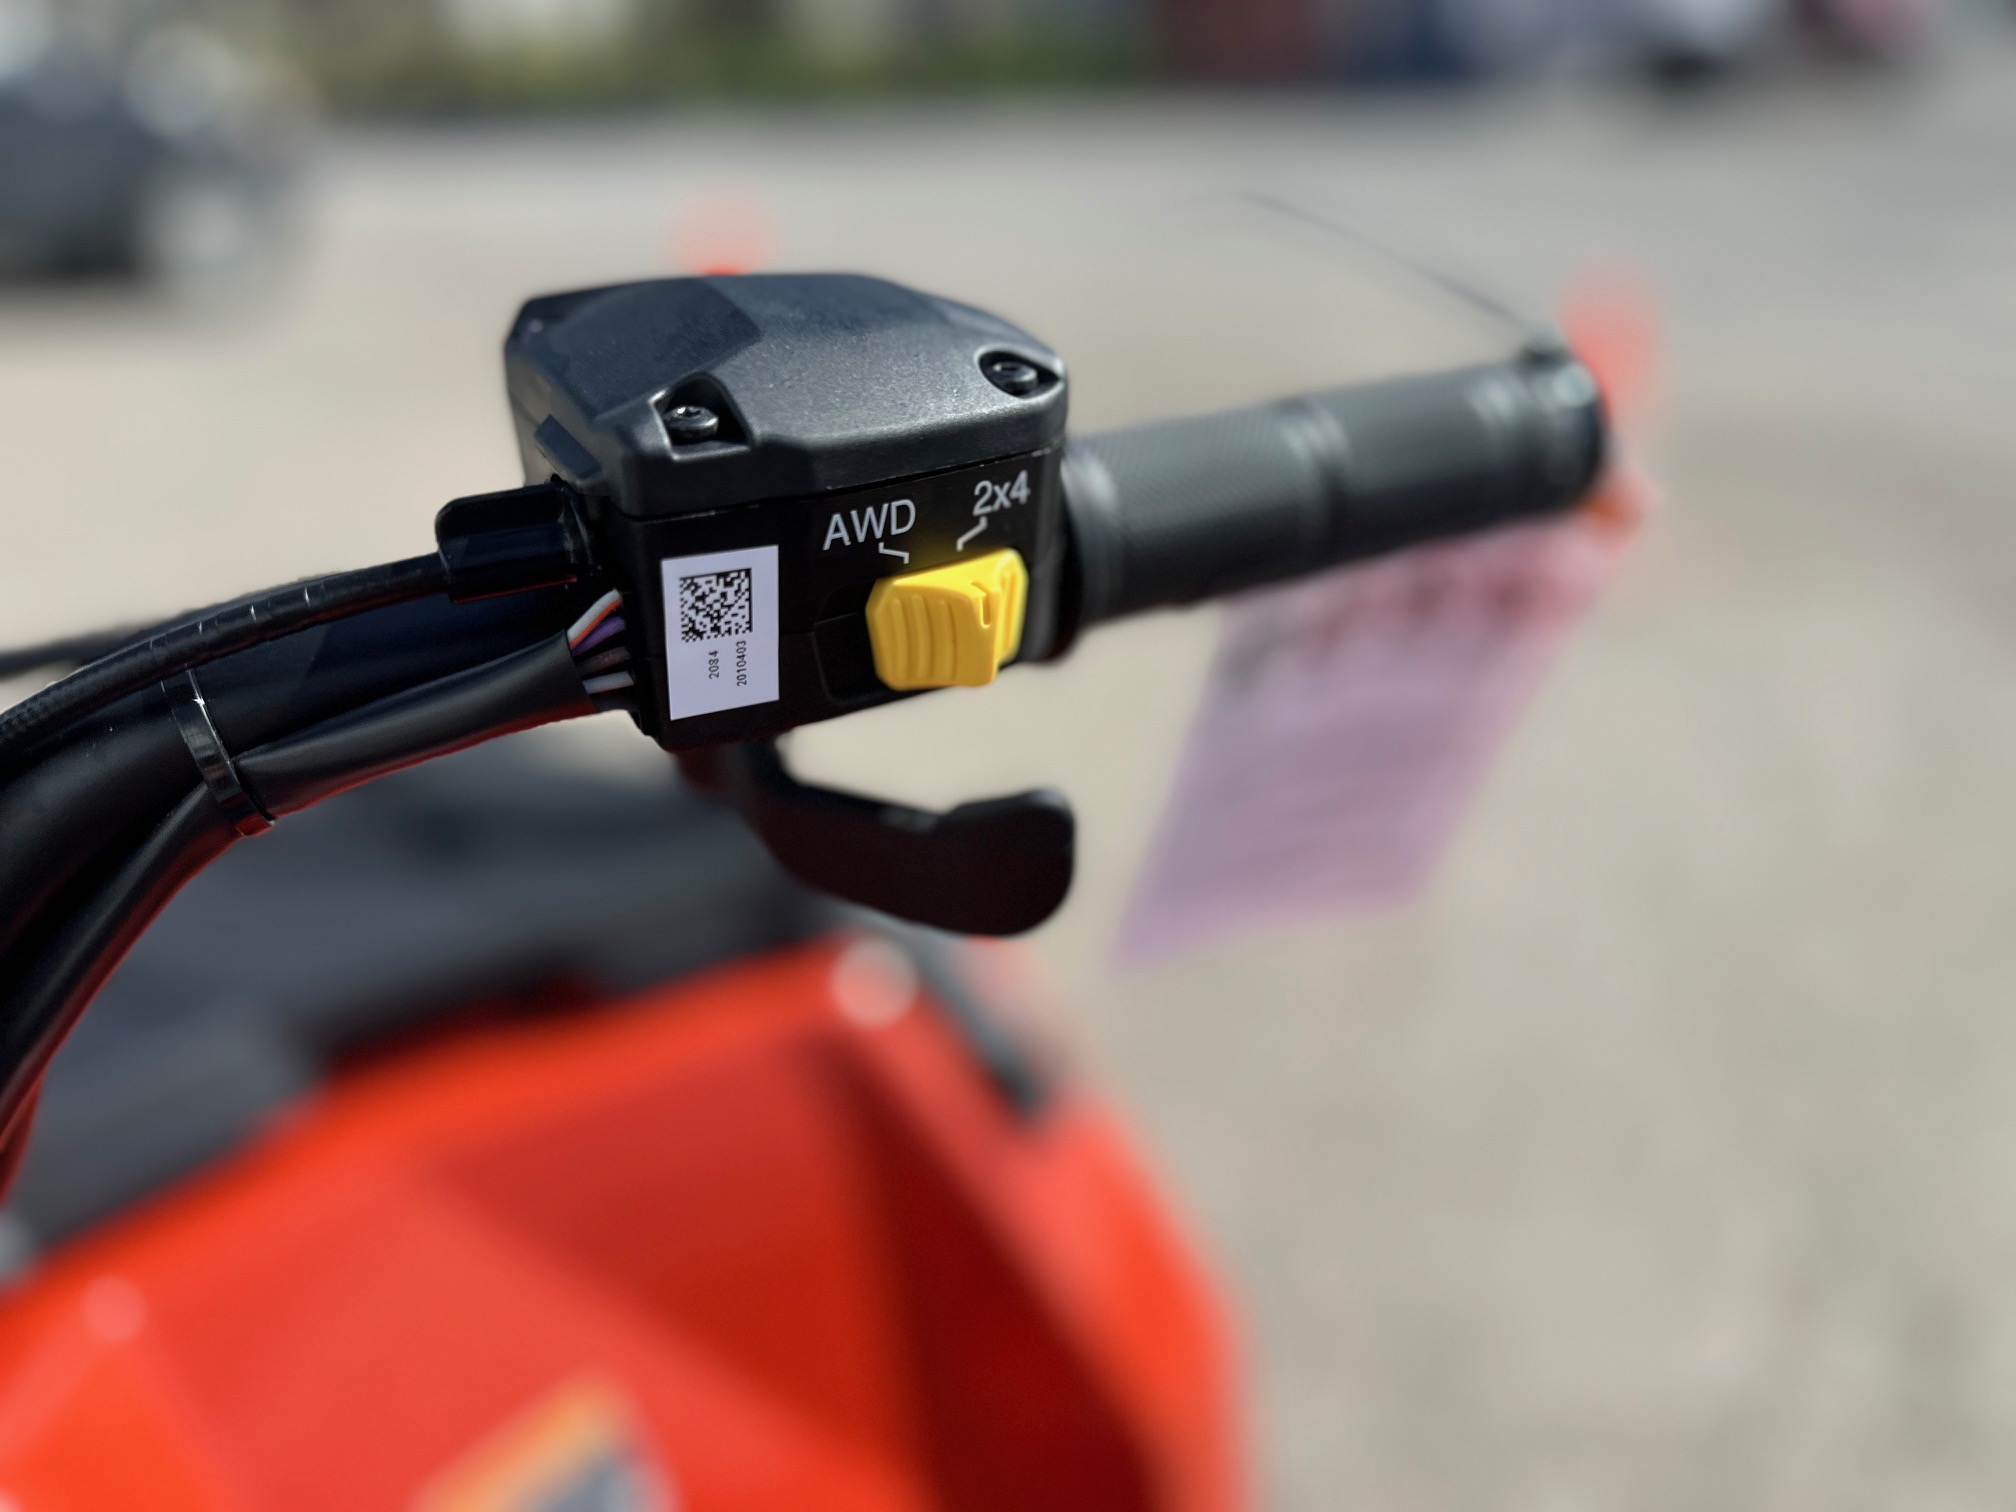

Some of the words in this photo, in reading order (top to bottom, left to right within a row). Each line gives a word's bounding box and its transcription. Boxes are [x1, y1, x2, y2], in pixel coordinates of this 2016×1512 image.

[972, 470, 1031, 516] 2x4
[822, 499, 917, 551] AWD
[708, 650, 720, 680] 2084
[735, 640, 748, 687] 2010403
